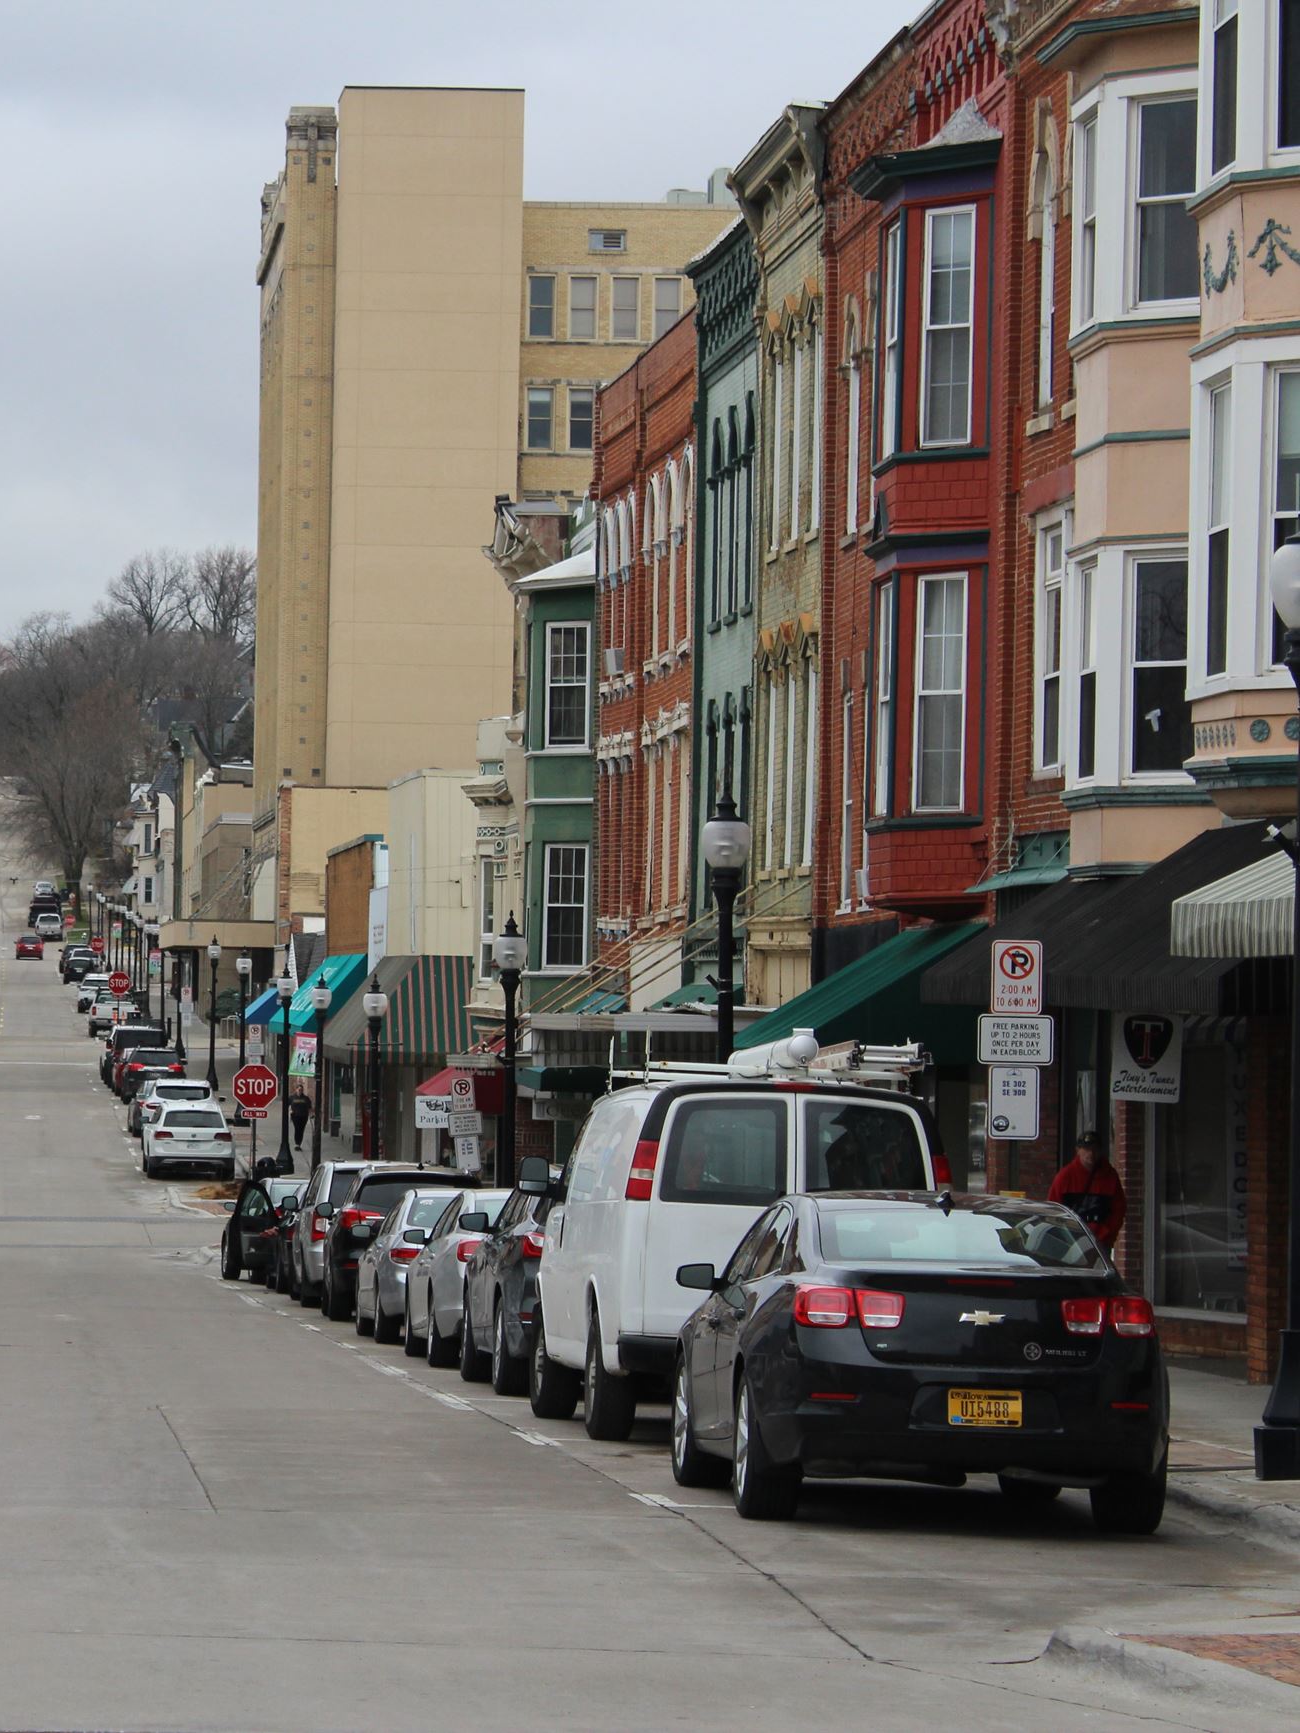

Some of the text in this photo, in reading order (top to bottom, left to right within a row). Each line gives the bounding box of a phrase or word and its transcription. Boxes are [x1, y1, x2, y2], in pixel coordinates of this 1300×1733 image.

[109, 978, 129, 988] STOP
[1001, 985, 1032, 995] 2:00 AM
[997, 997, 1004, 1007] TO
[1027, 998, 1037, 1007] AM
[992, 1022, 1039, 1031] FREE PARKING
[990, 1031, 999, 1039] UP
[1002, 1031, 1010, 1039] TO
[1012, 1031, 1018, 1039] 2
[1011, 1040, 1024, 1048] PER
[991, 1048, 997, 1056] IN
[1120, 1070, 1175, 1085] Tiny's Tunes
[237, 1079, 274, 1095] STOP
[1112, 1080, 1178, 1096] Entertainment
[961, 1400, 1009, 1418] UI5488
